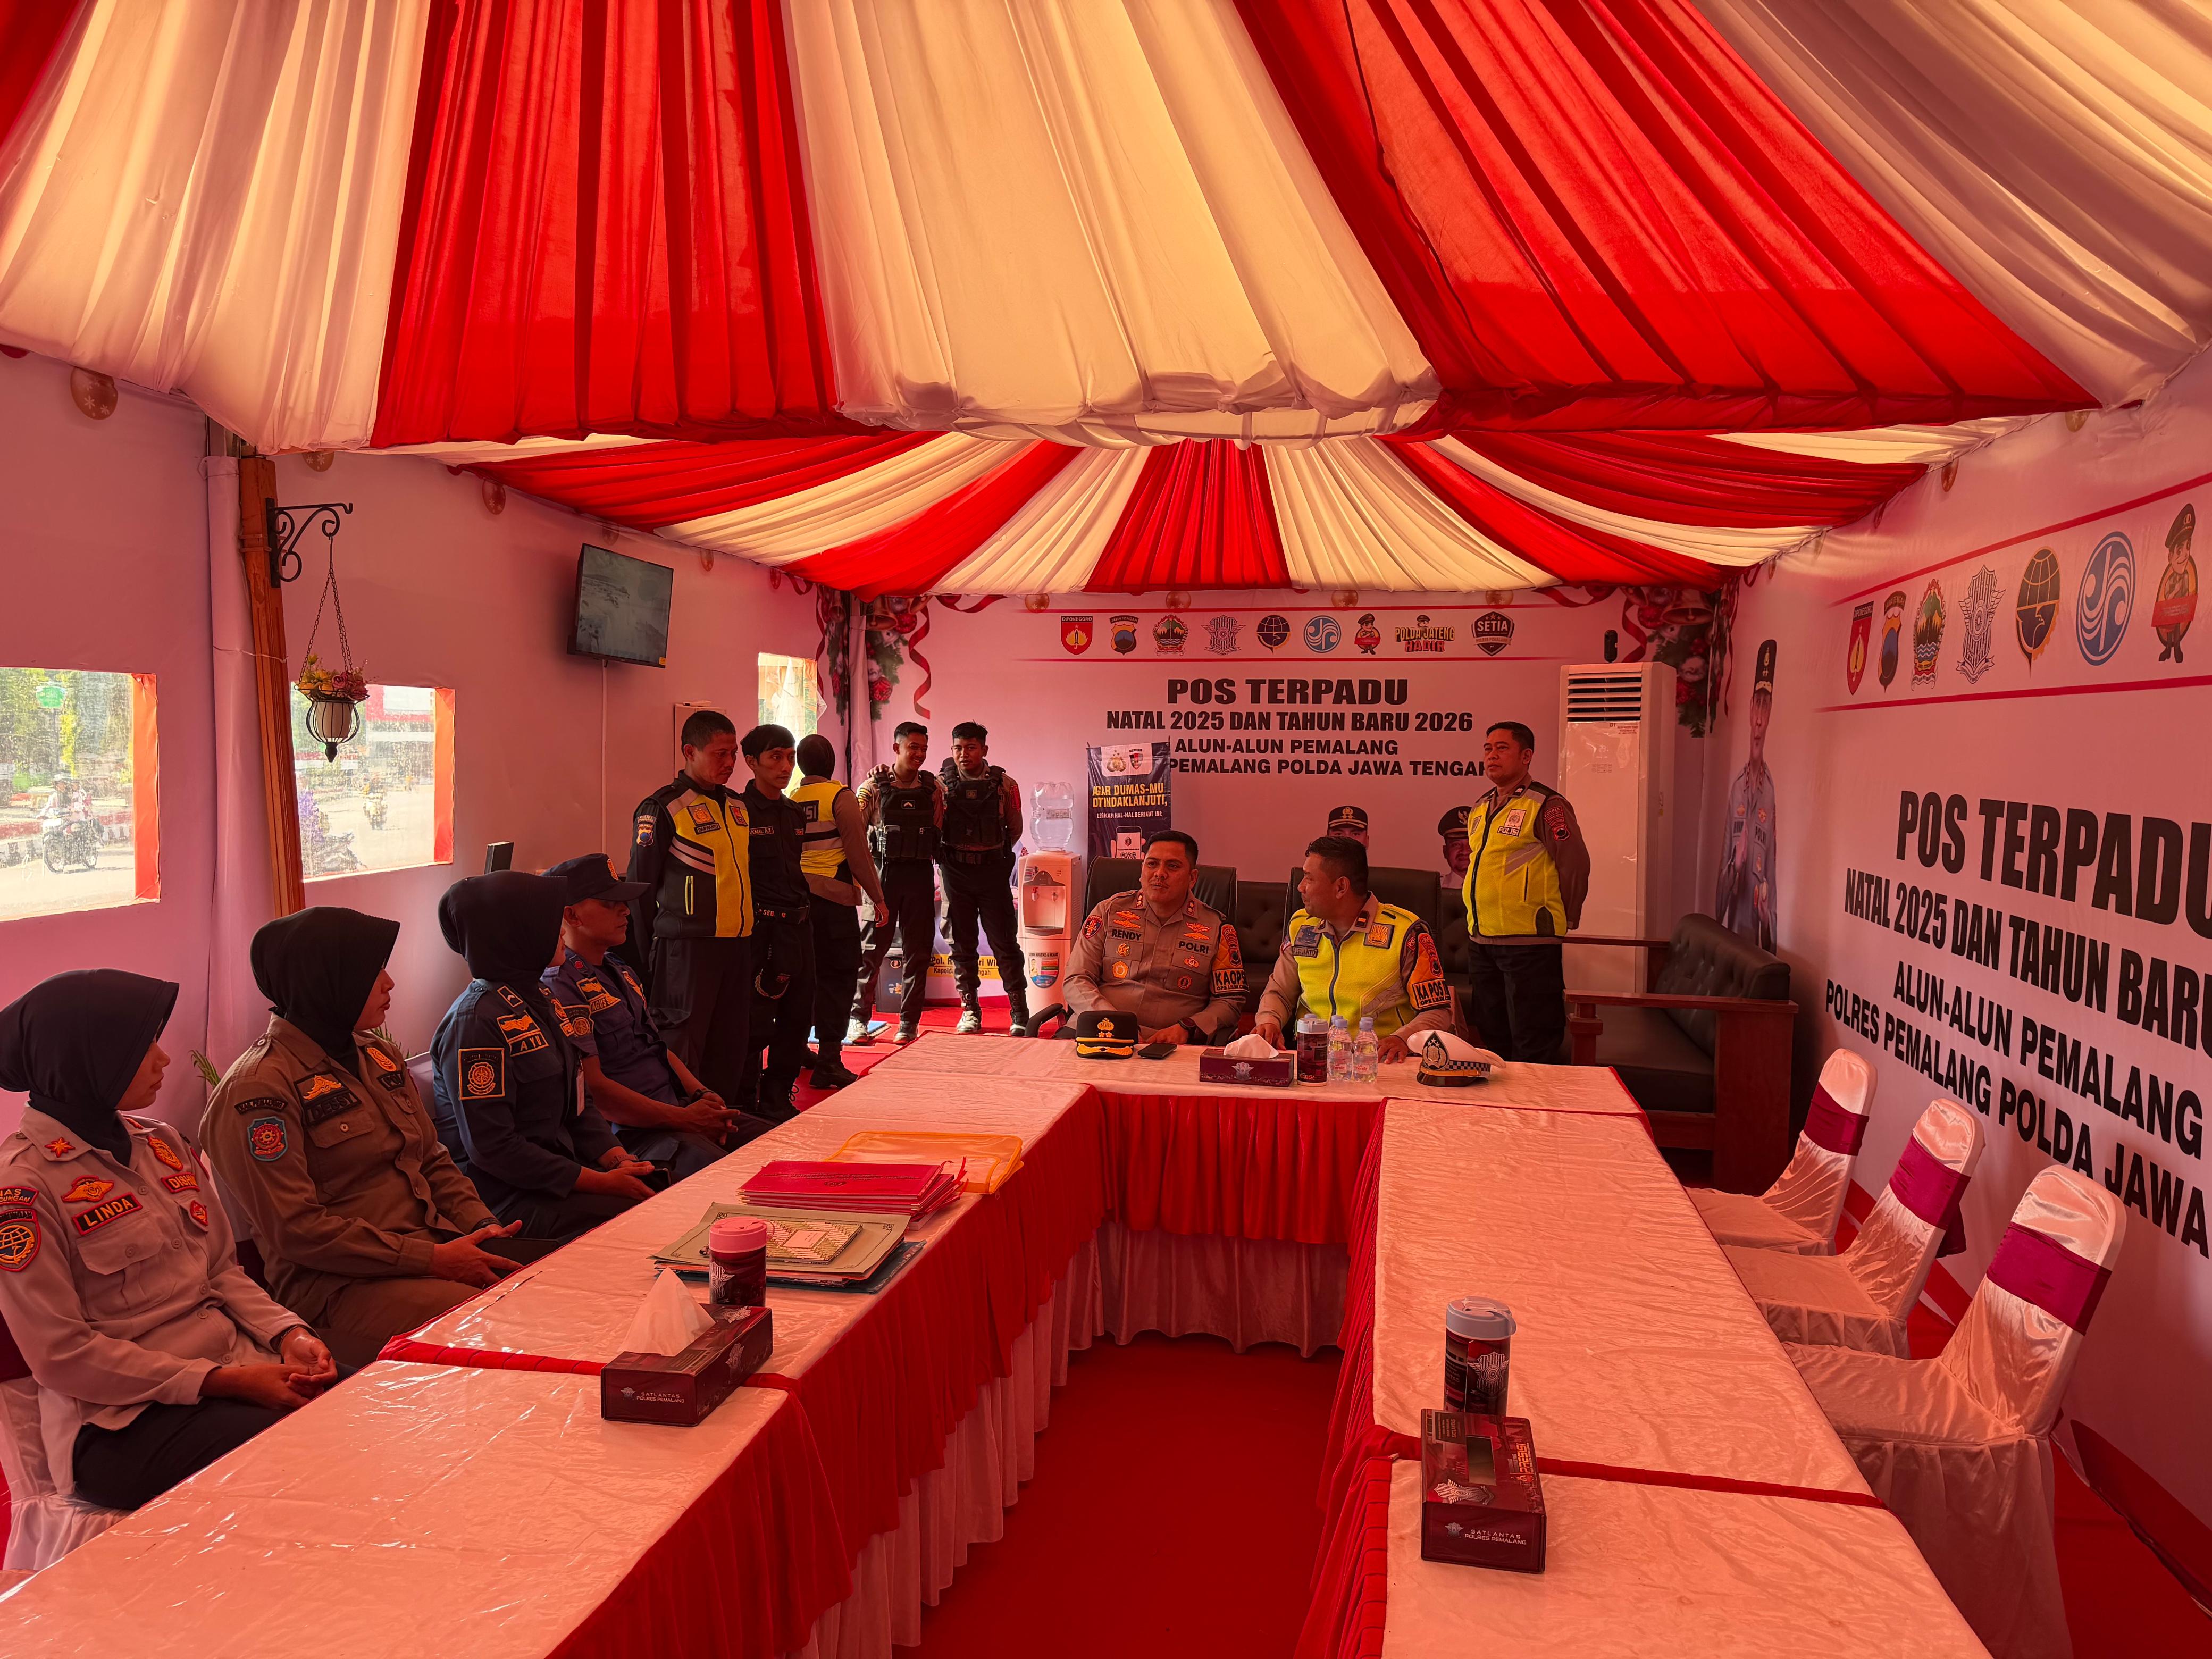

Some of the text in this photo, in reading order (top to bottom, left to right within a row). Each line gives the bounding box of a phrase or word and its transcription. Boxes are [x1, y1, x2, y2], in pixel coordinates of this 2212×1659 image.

[1477, 621, 1508, 631] SETIA
[1395, 627, 1455, 642] POLDA JATENG
[1404, 640, 1445, 652] HADIR
[1167, 678, 1409, 705] POS TERPADU
[1107, 711, 1473, 732] NATAL 2025 DAN TAHUN BARU 2026
[1174, 739, 1398, 755] ALUN-ALUN PEMALANG
[1170, 758, 1271, 774] PEMALANG
[1277, 759, 1343, 775] POLDA
[1348, 760, 1403, 776] JAWA
[1114, 783, 1164, 795] DUMAS-MU
[1498, 827, 1519, 836] POLISI
[1896, 790, 1967, 874] POS
[1111, 929, 1142, 941] RENDY
[1844, 867, 1890, 929] NATAL
[1893, 882, 1948, 949] 2025
[1951, 898, 2002, 971] DAN
[2009, 914, 2110, 1013] TAHUN
[1178, 941, 1210, 954] POLRI
[1416, 984, 1429, 1001] KA
[1427, 981, 1444, 998] POS
[591, 998, 607, 1011] AGUS
[1893, 960, 2203, 1160] ALUN-ALUN PEMALANG
[1825, 978, 2210, 1260] POLRES PEMALANG POLDA JAWA
[83, 1198, 134, 1227] LINDA
[1516, 1443, 1534, 1473] PRESISI
[1471, 1529, 1521, 1539] SATLANTAS
[1490, 1536, 1527, 1545] PEMALANG
